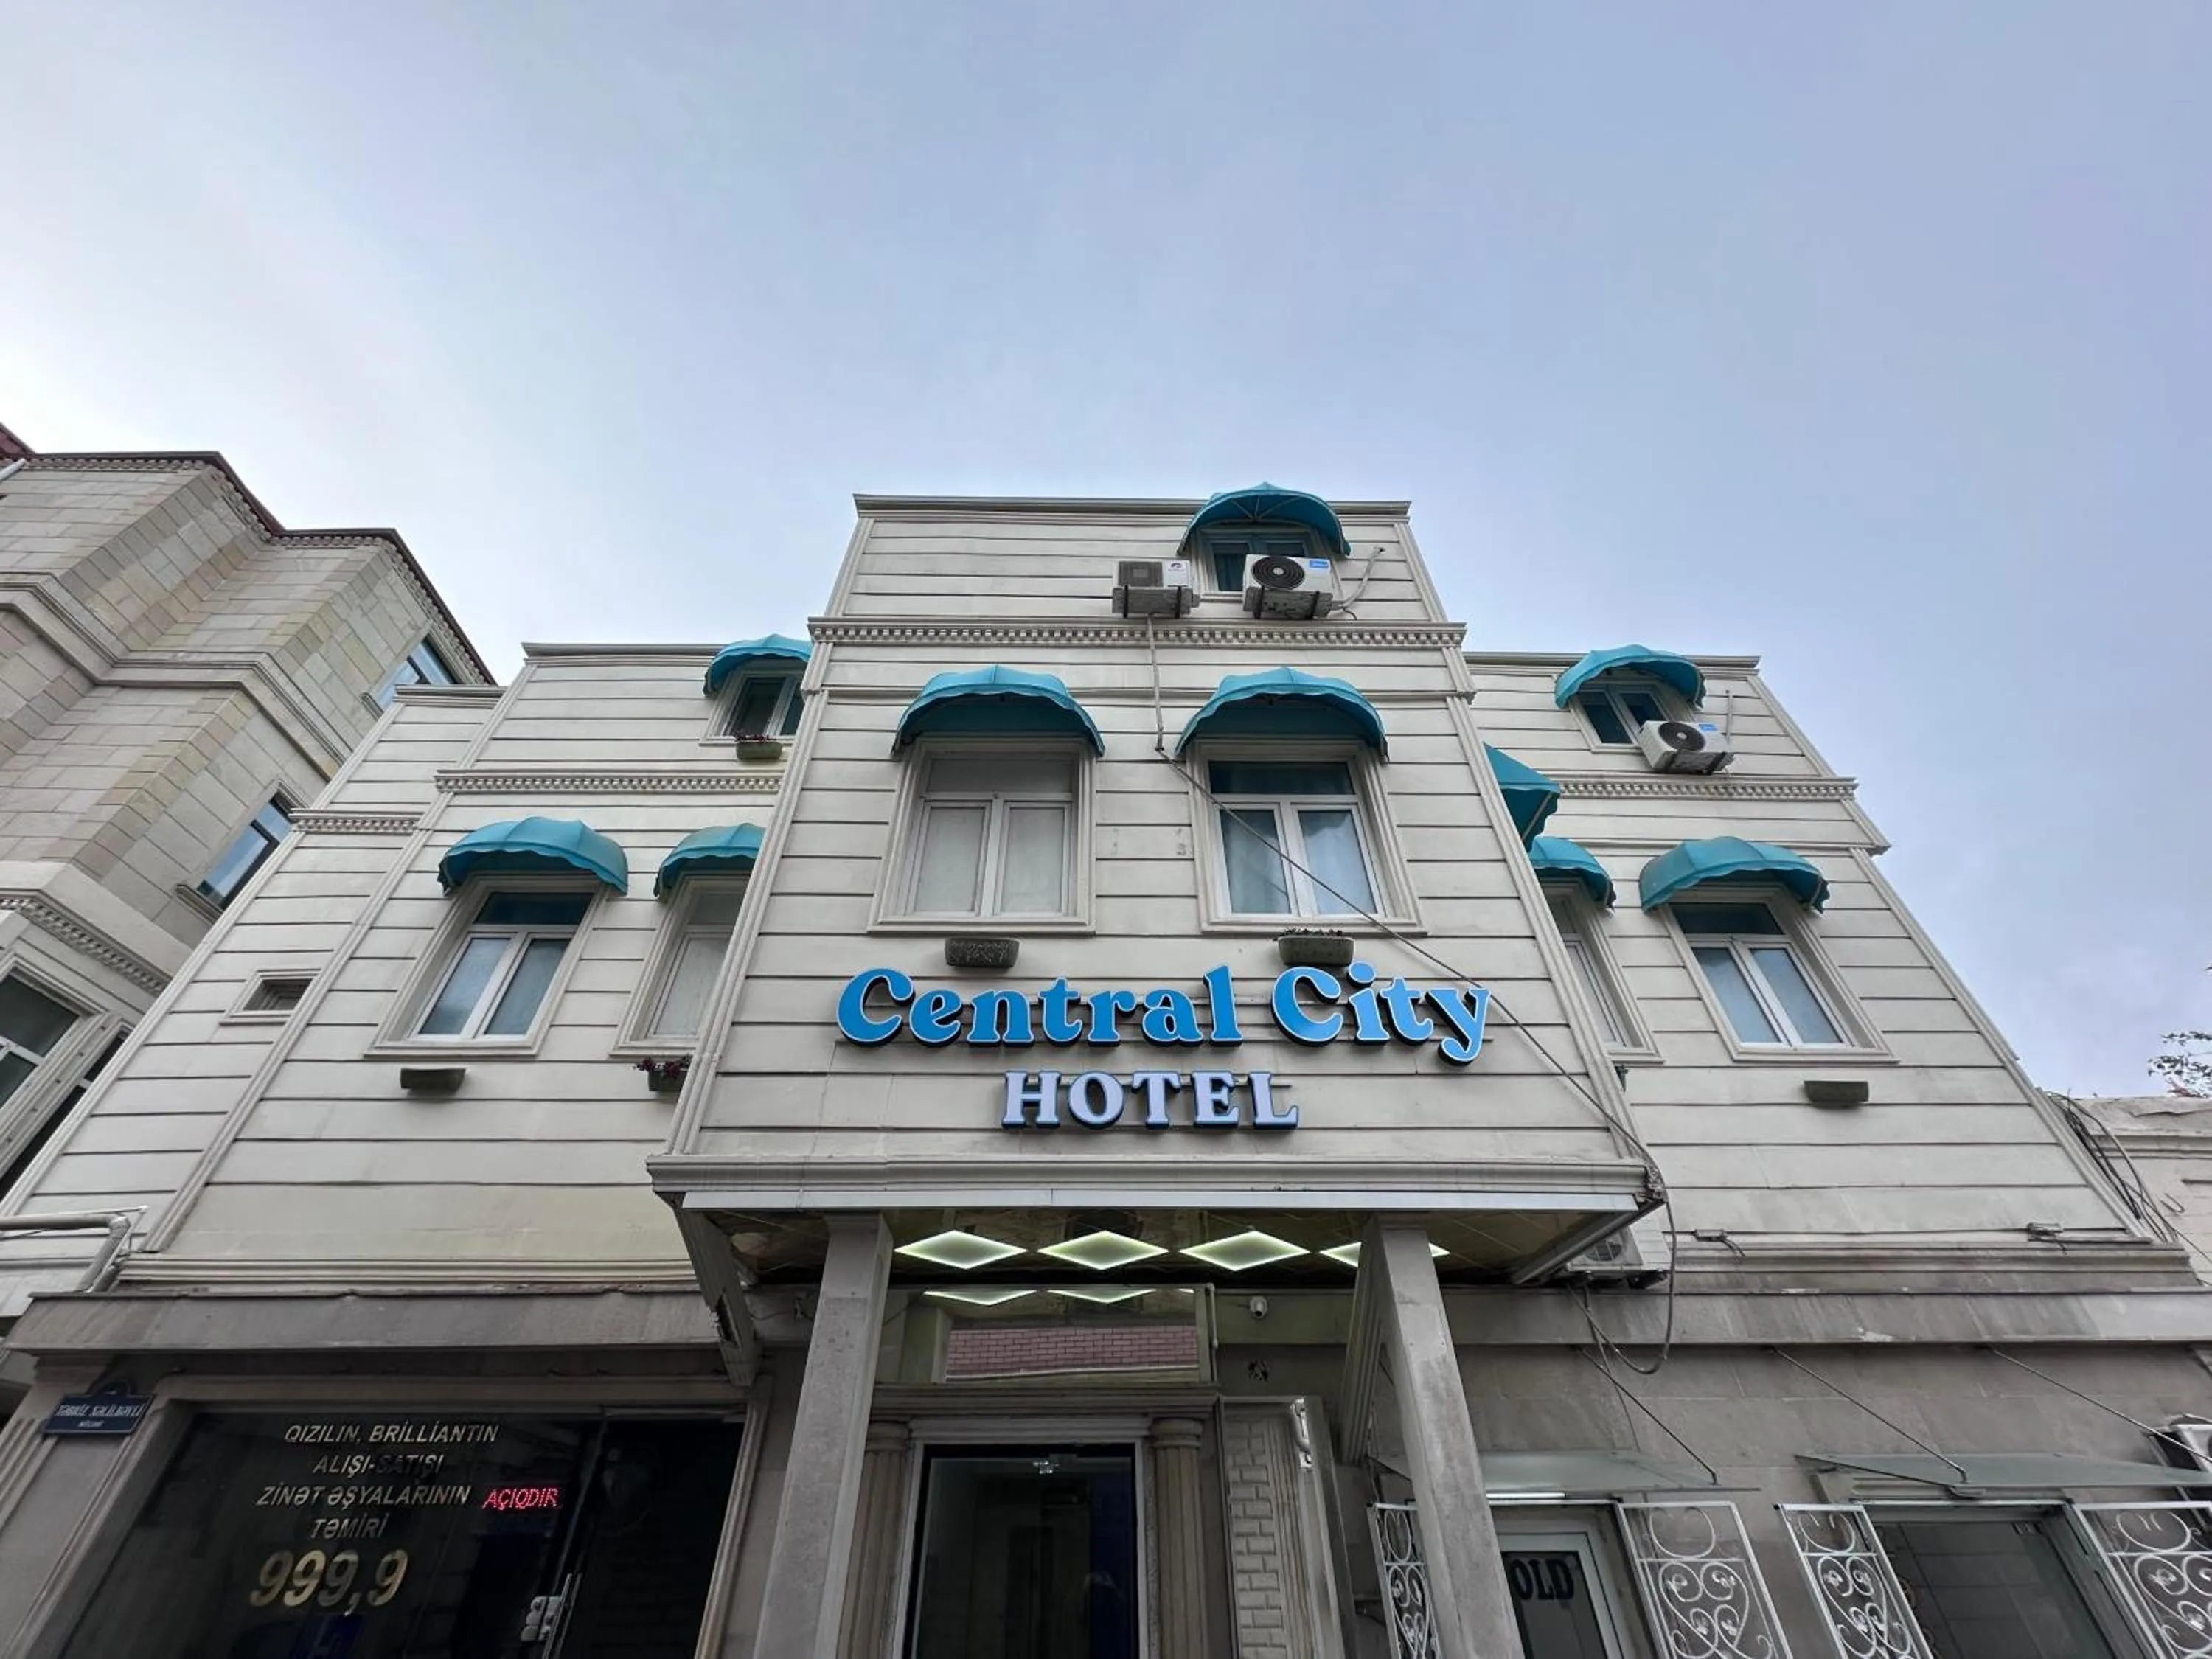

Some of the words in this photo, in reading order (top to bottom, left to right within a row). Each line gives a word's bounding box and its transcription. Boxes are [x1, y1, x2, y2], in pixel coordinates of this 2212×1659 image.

[836, 964, 1243, 1047] Central
[1271, 961, 1492, 1065] City
[1001, 1069, 1301, 1130] HOTEL
[250, 1549, 409, 1617] 999,9
[1509, 1558, 1575, 1600] OLD
